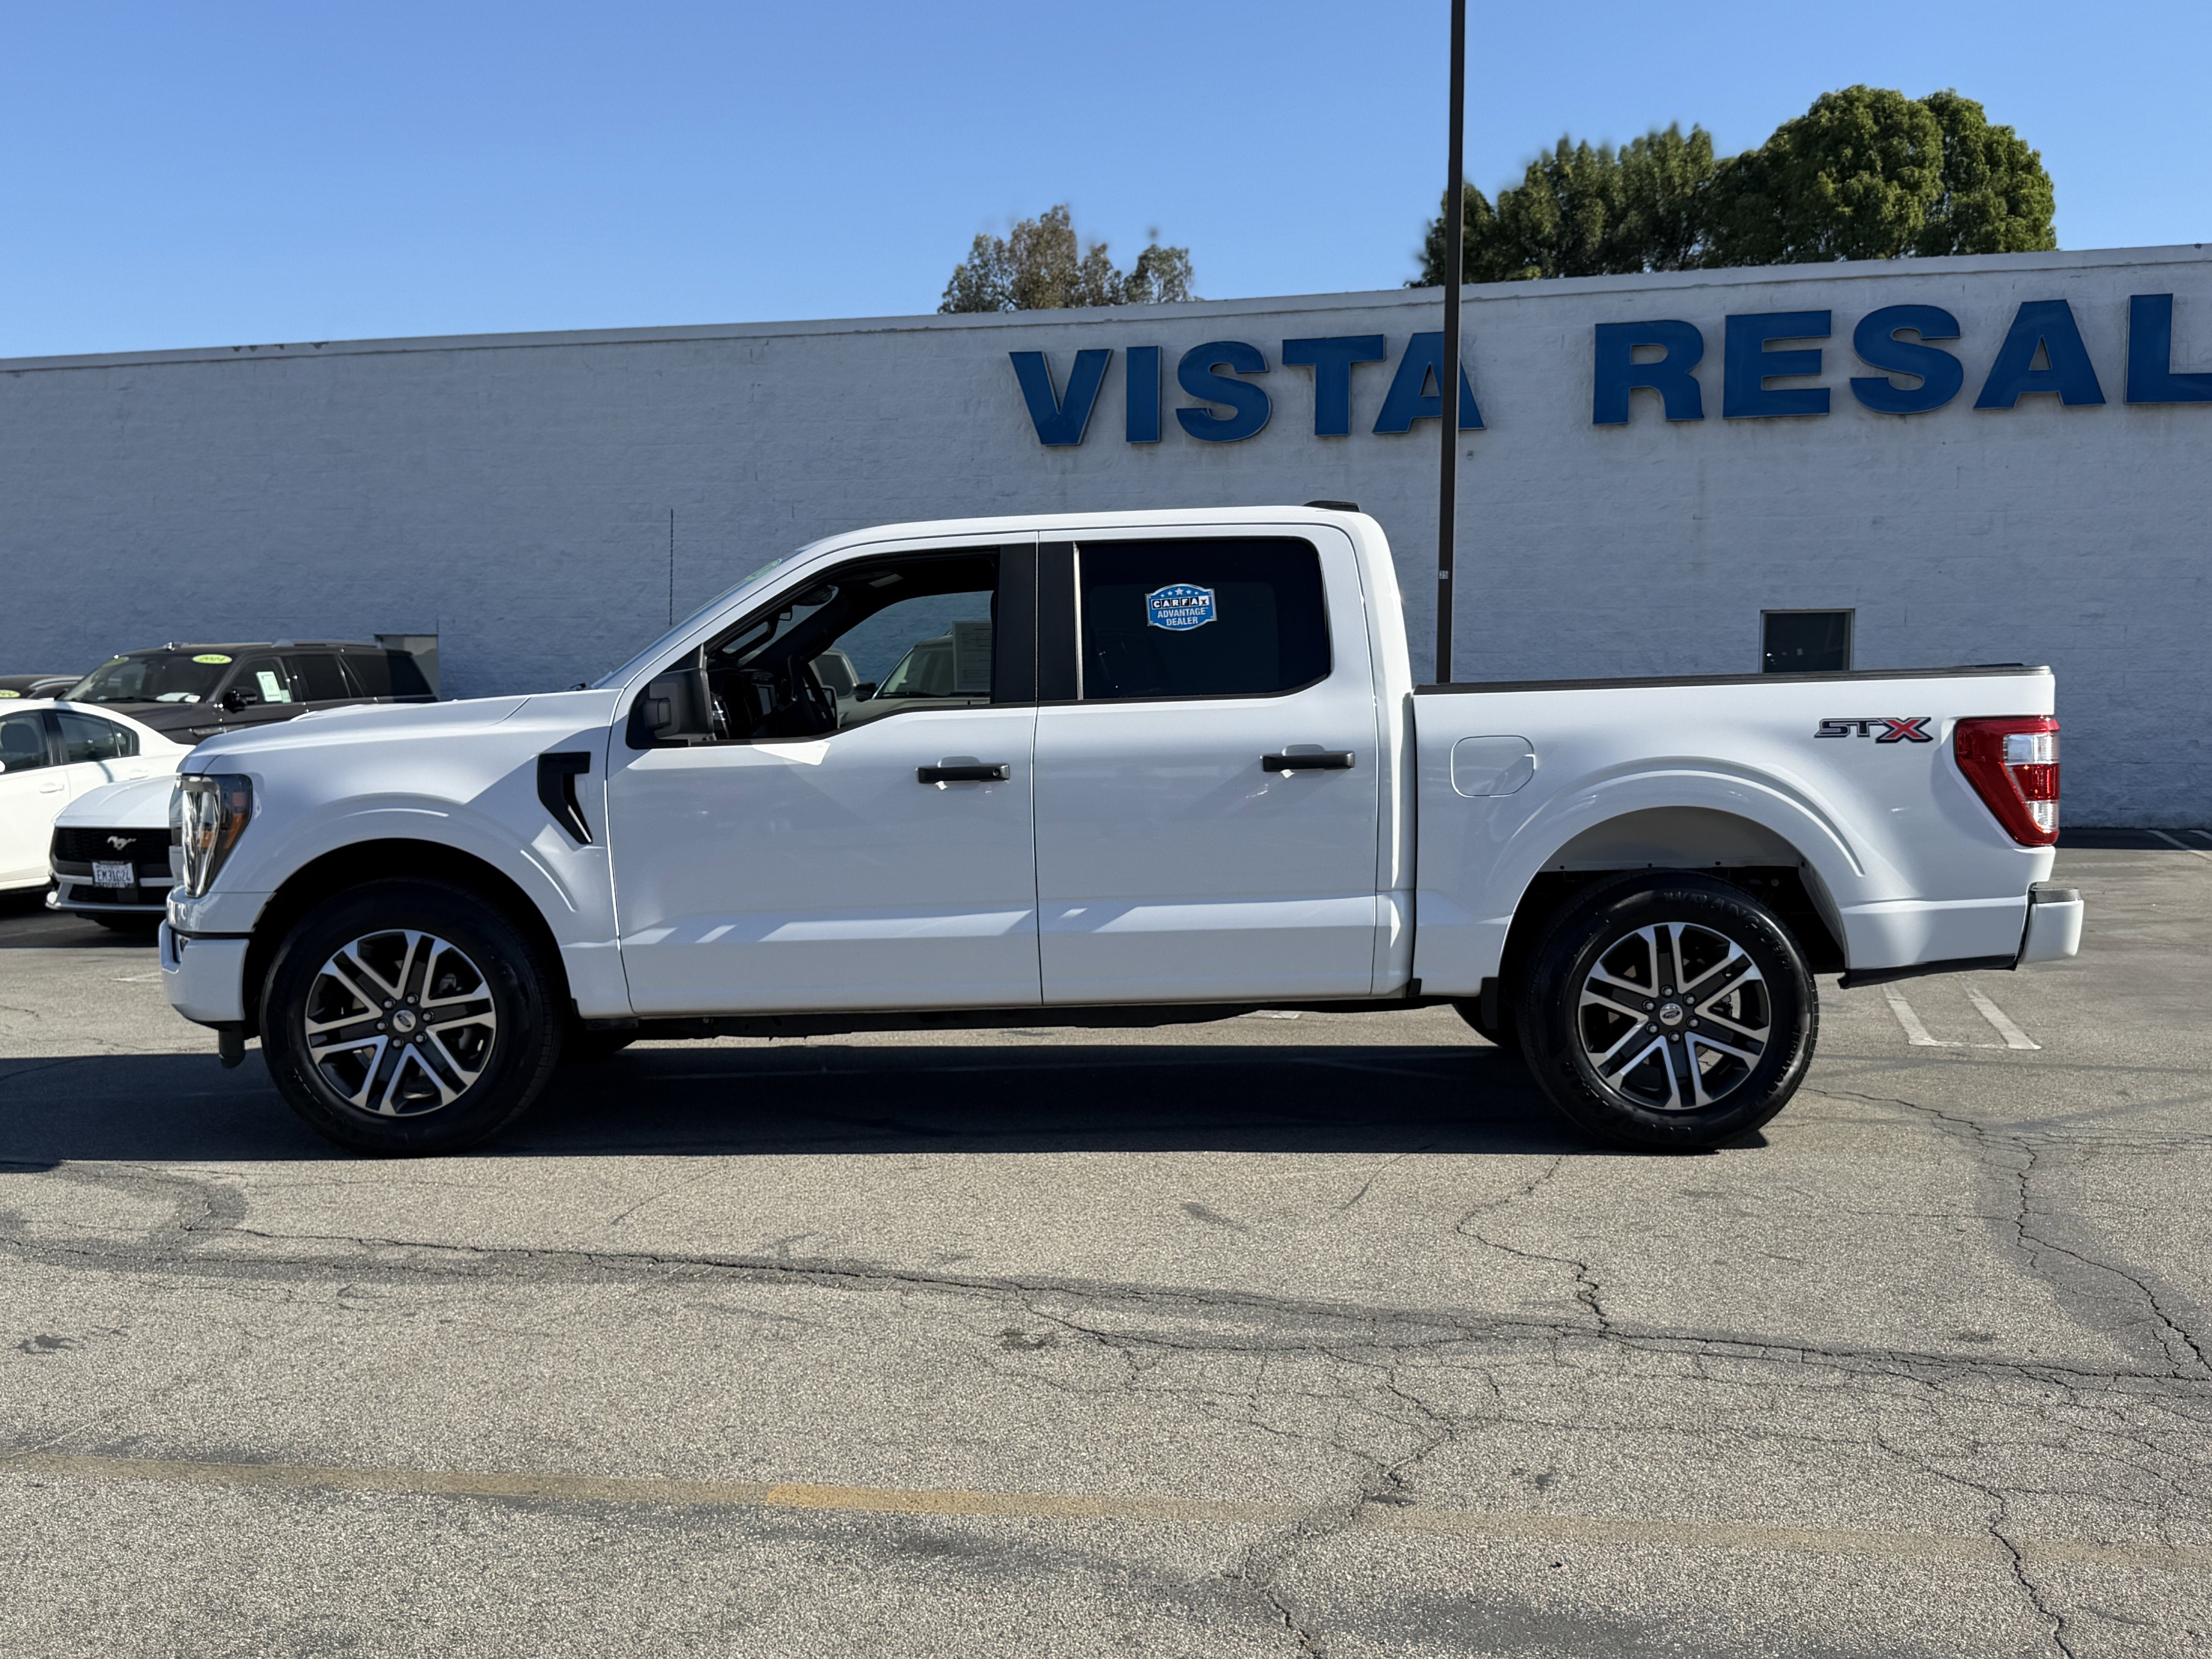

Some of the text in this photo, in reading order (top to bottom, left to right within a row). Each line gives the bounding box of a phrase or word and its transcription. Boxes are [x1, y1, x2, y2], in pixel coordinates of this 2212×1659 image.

[1009, 293, 2212, 445] VISTA RESAL
[1152, 597, 1208, 608] CARFAX
[1158, 608, 1206, 618] ADVANTAGE
[1166, 617, 1198, 626] DEALER
[1814, 717, 1933, 743] STX
